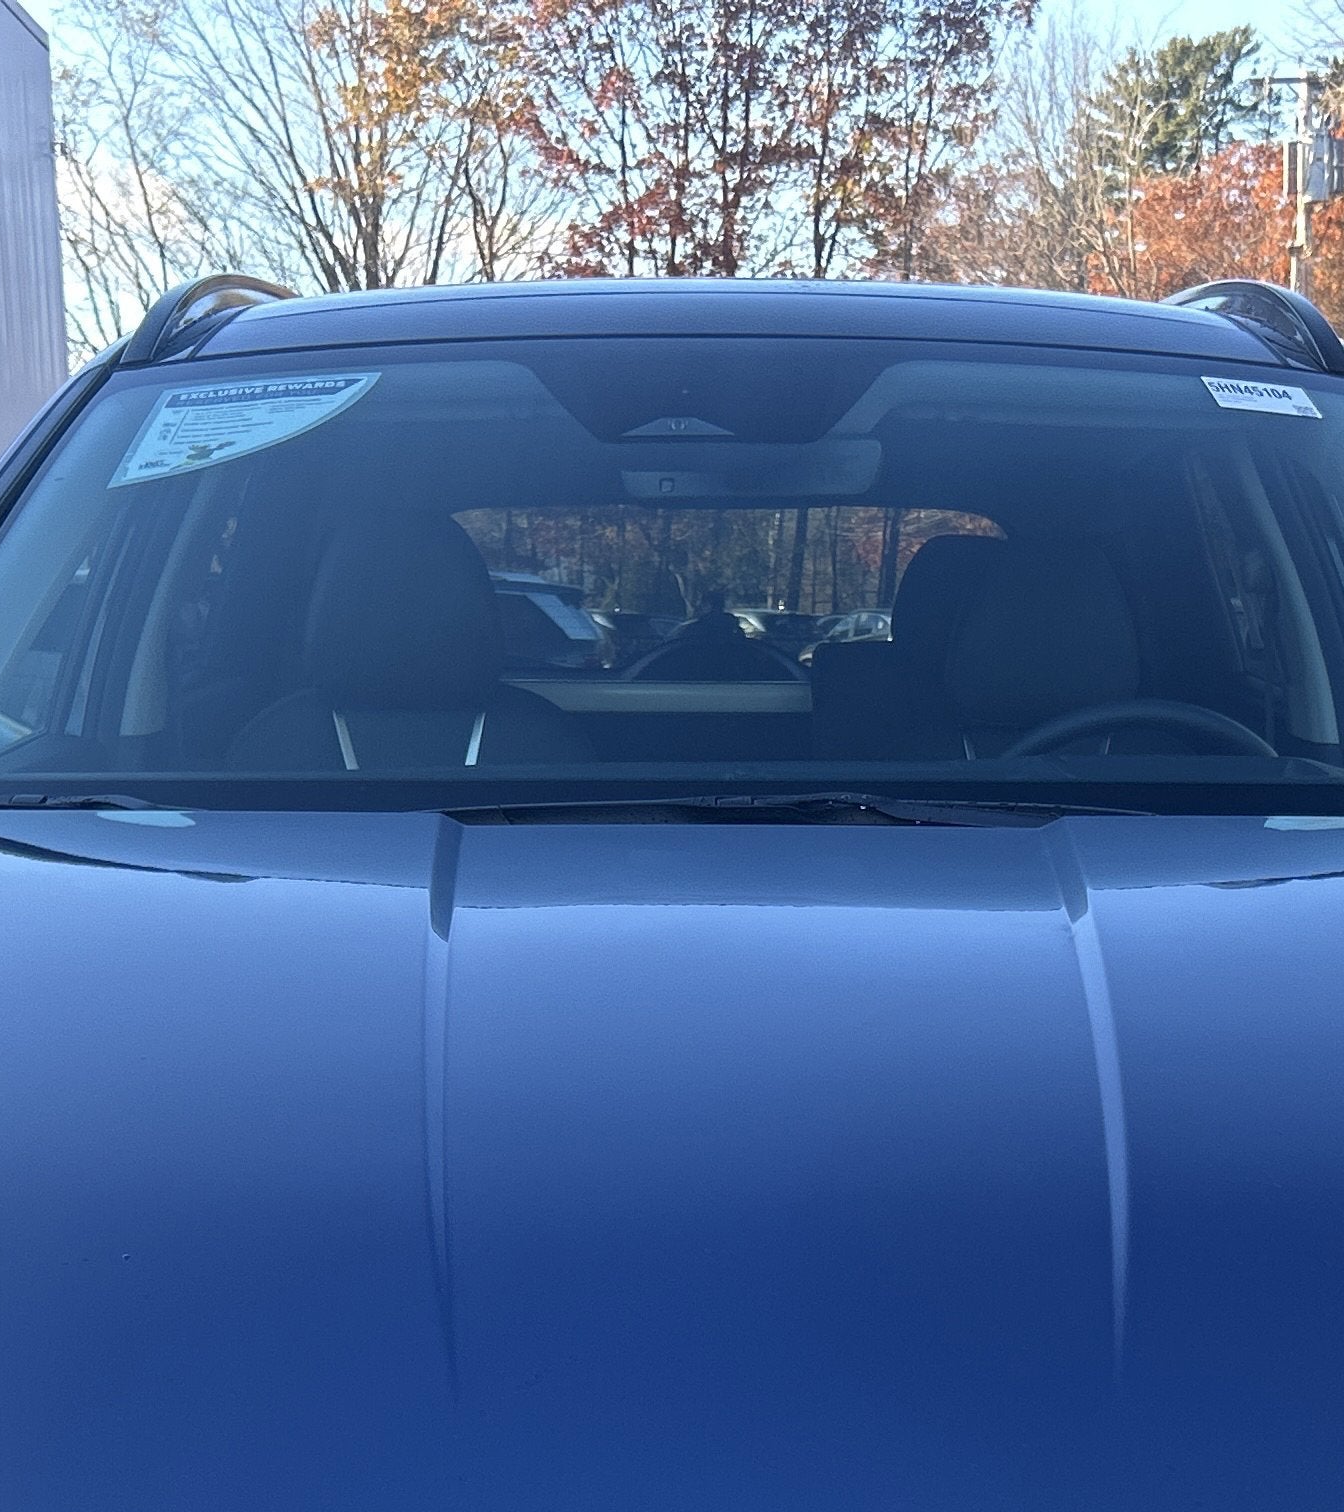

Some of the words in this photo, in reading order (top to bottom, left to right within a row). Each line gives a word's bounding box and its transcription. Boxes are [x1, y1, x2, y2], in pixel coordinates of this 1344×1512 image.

[179, 386, 264, 401] EXCLUSIVE
[267, 380, 346, 392] REWARDS
[1207, 381, 1293, 401] 5HN45104
